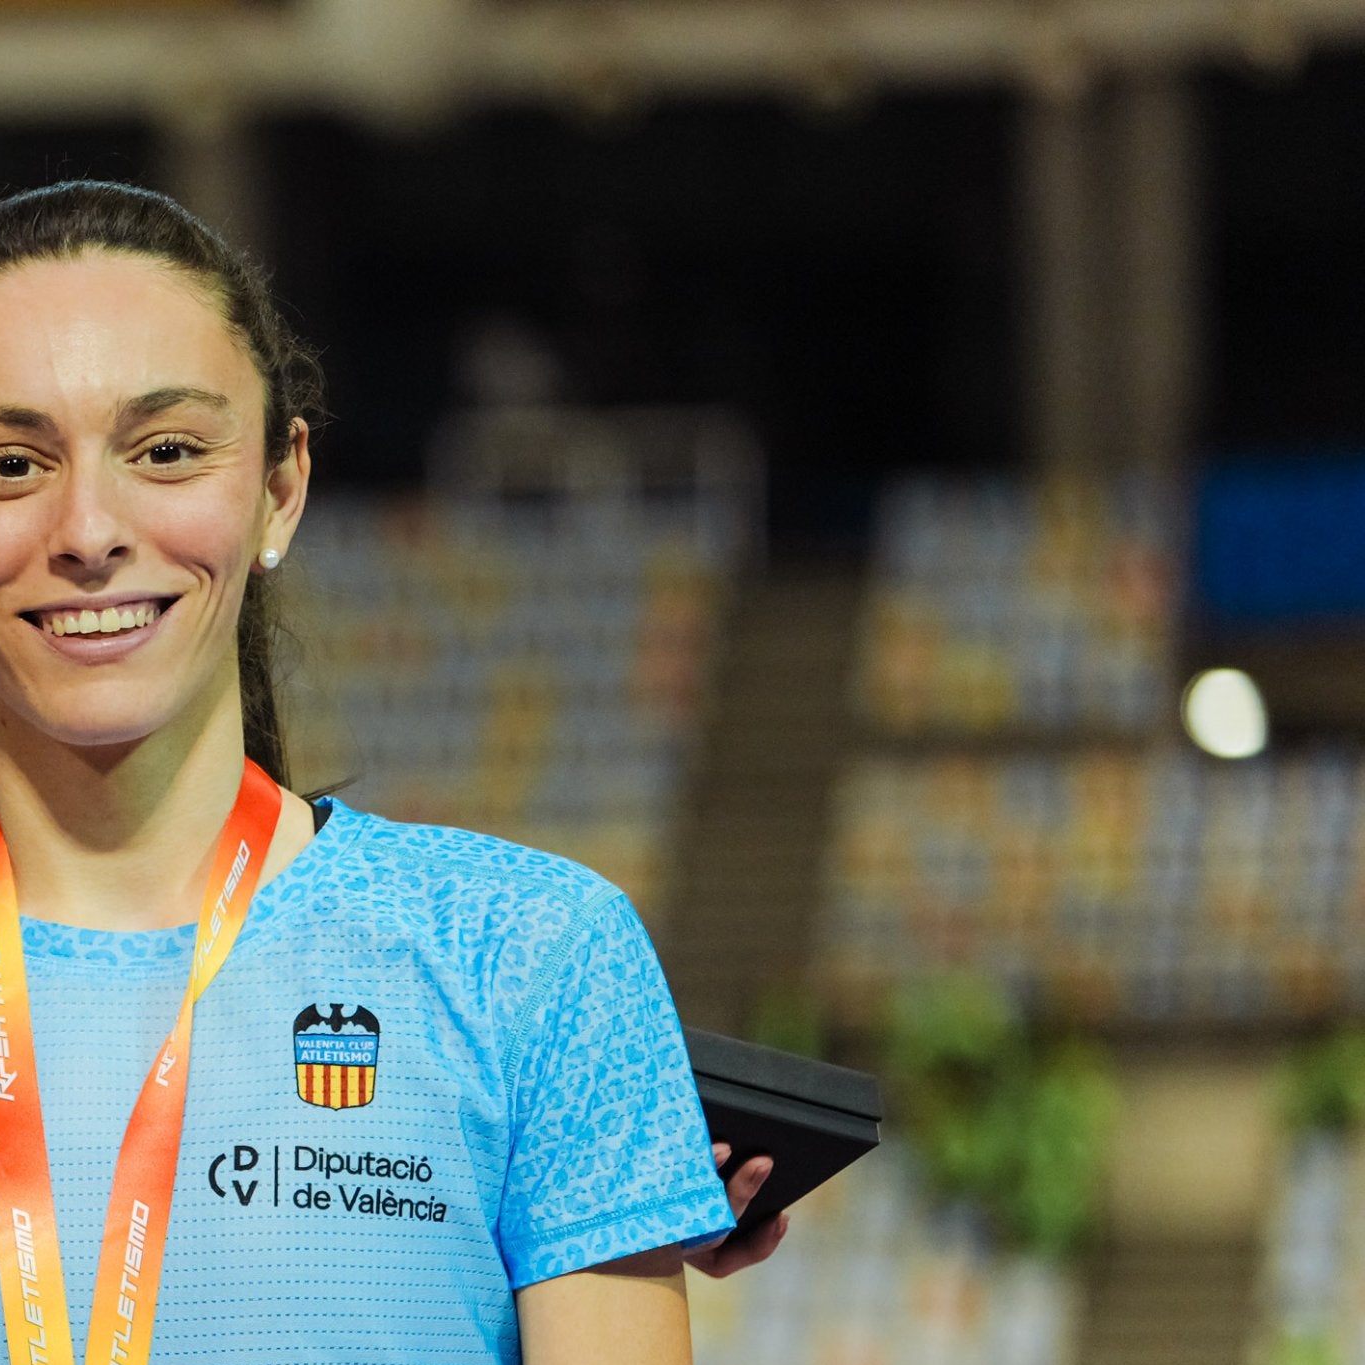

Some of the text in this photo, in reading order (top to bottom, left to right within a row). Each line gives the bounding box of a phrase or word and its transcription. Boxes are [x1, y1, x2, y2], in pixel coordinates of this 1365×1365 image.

[194, 839, 251, 980] TLETISMO
[301, 1051, 372, 1062] ATLETISMO
[348, 1041, 375, 1050] CLUB
[294, 1145, 433, 1182] Diputació
[293, 1183, 447, 1223] de València
